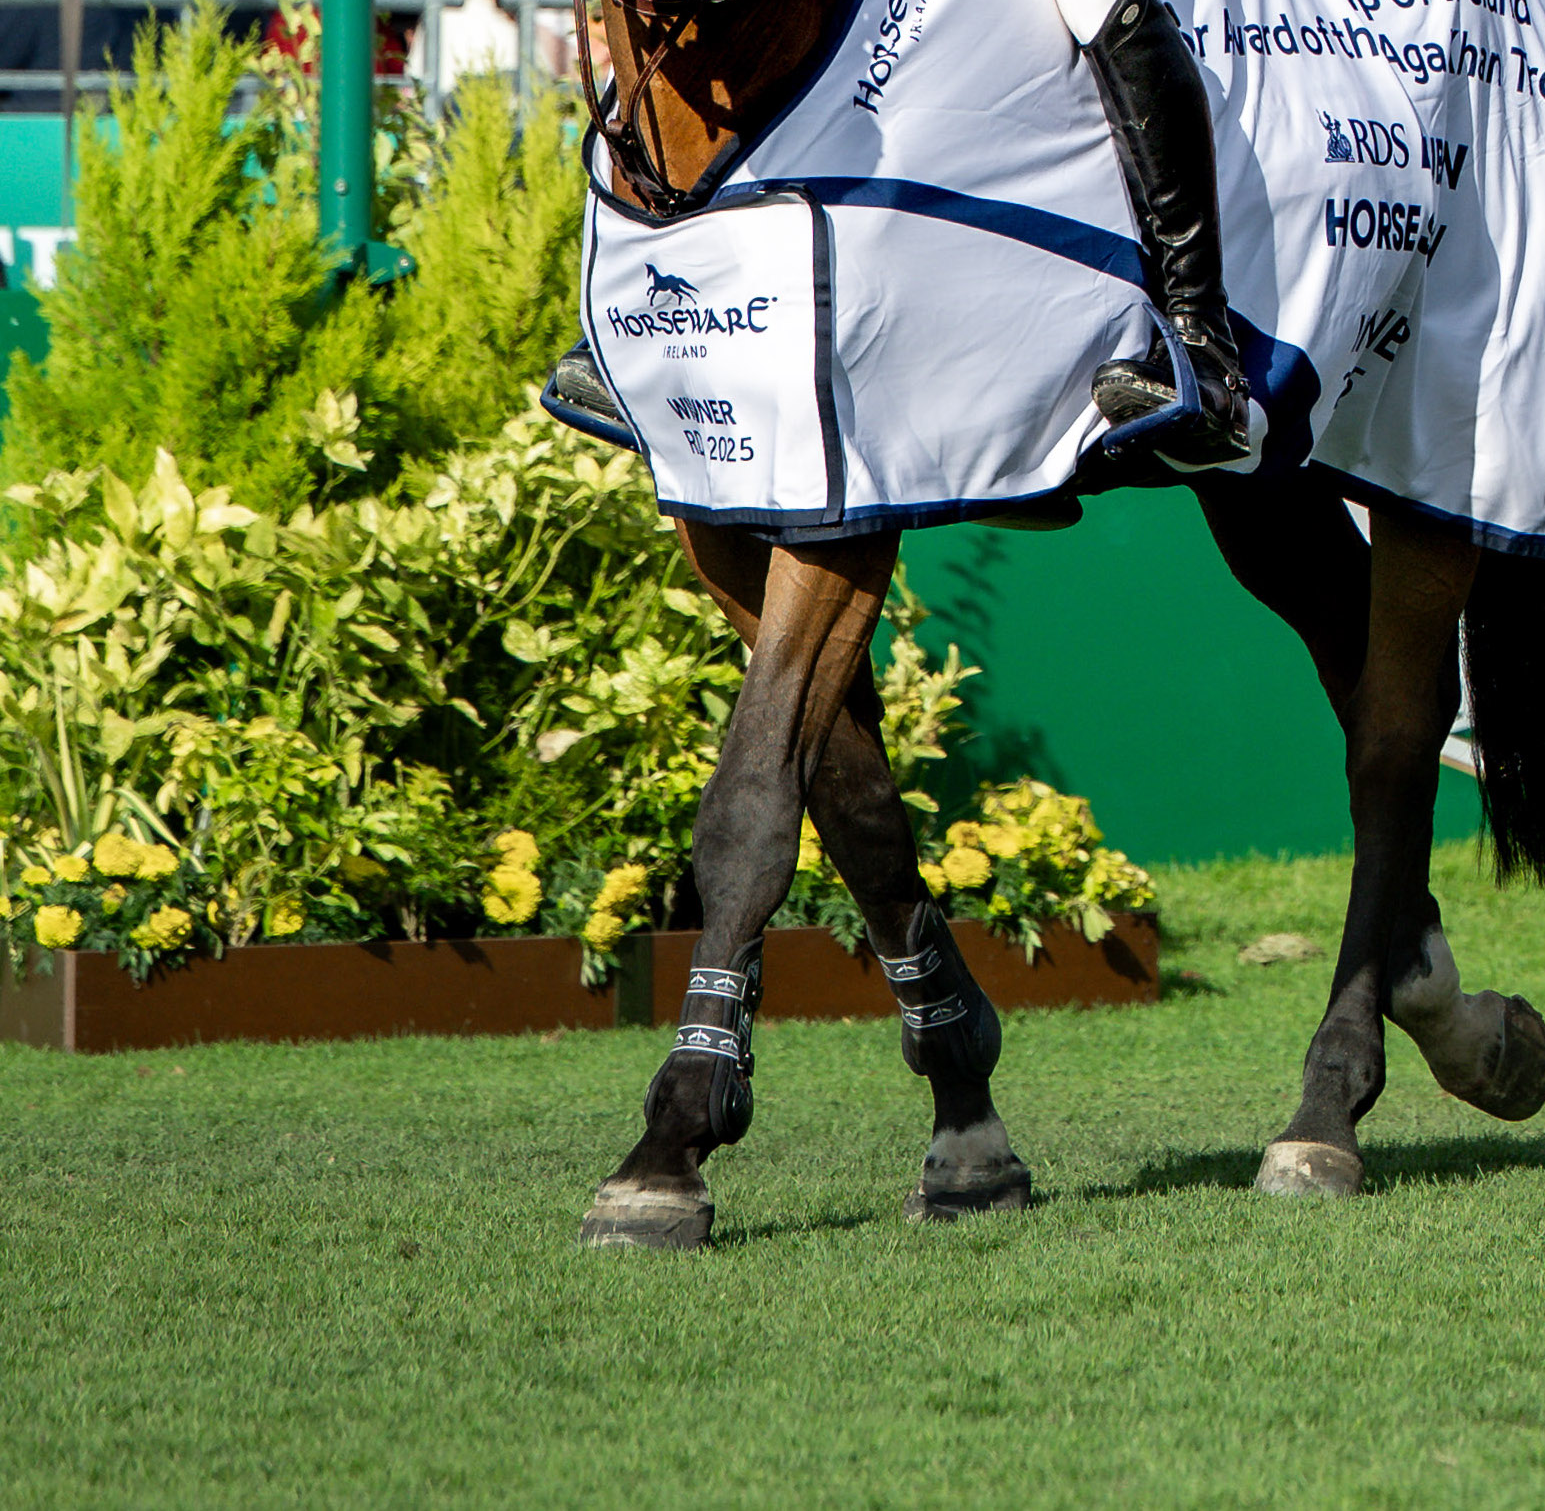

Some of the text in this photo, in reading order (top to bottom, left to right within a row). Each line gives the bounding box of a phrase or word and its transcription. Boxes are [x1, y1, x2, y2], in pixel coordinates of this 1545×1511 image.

[1300, 15, 1336, 56] of
[1378, 33, 1448, 85] Aga
[1348, 118, 1410, 170] RDS
[1325, 198, 1422, 252] HORSE
[606, 295, 771, 339] HORSEWARE
[662, 344, 708, 359] IRELAND
[706, 435, 755, 463] 2025
